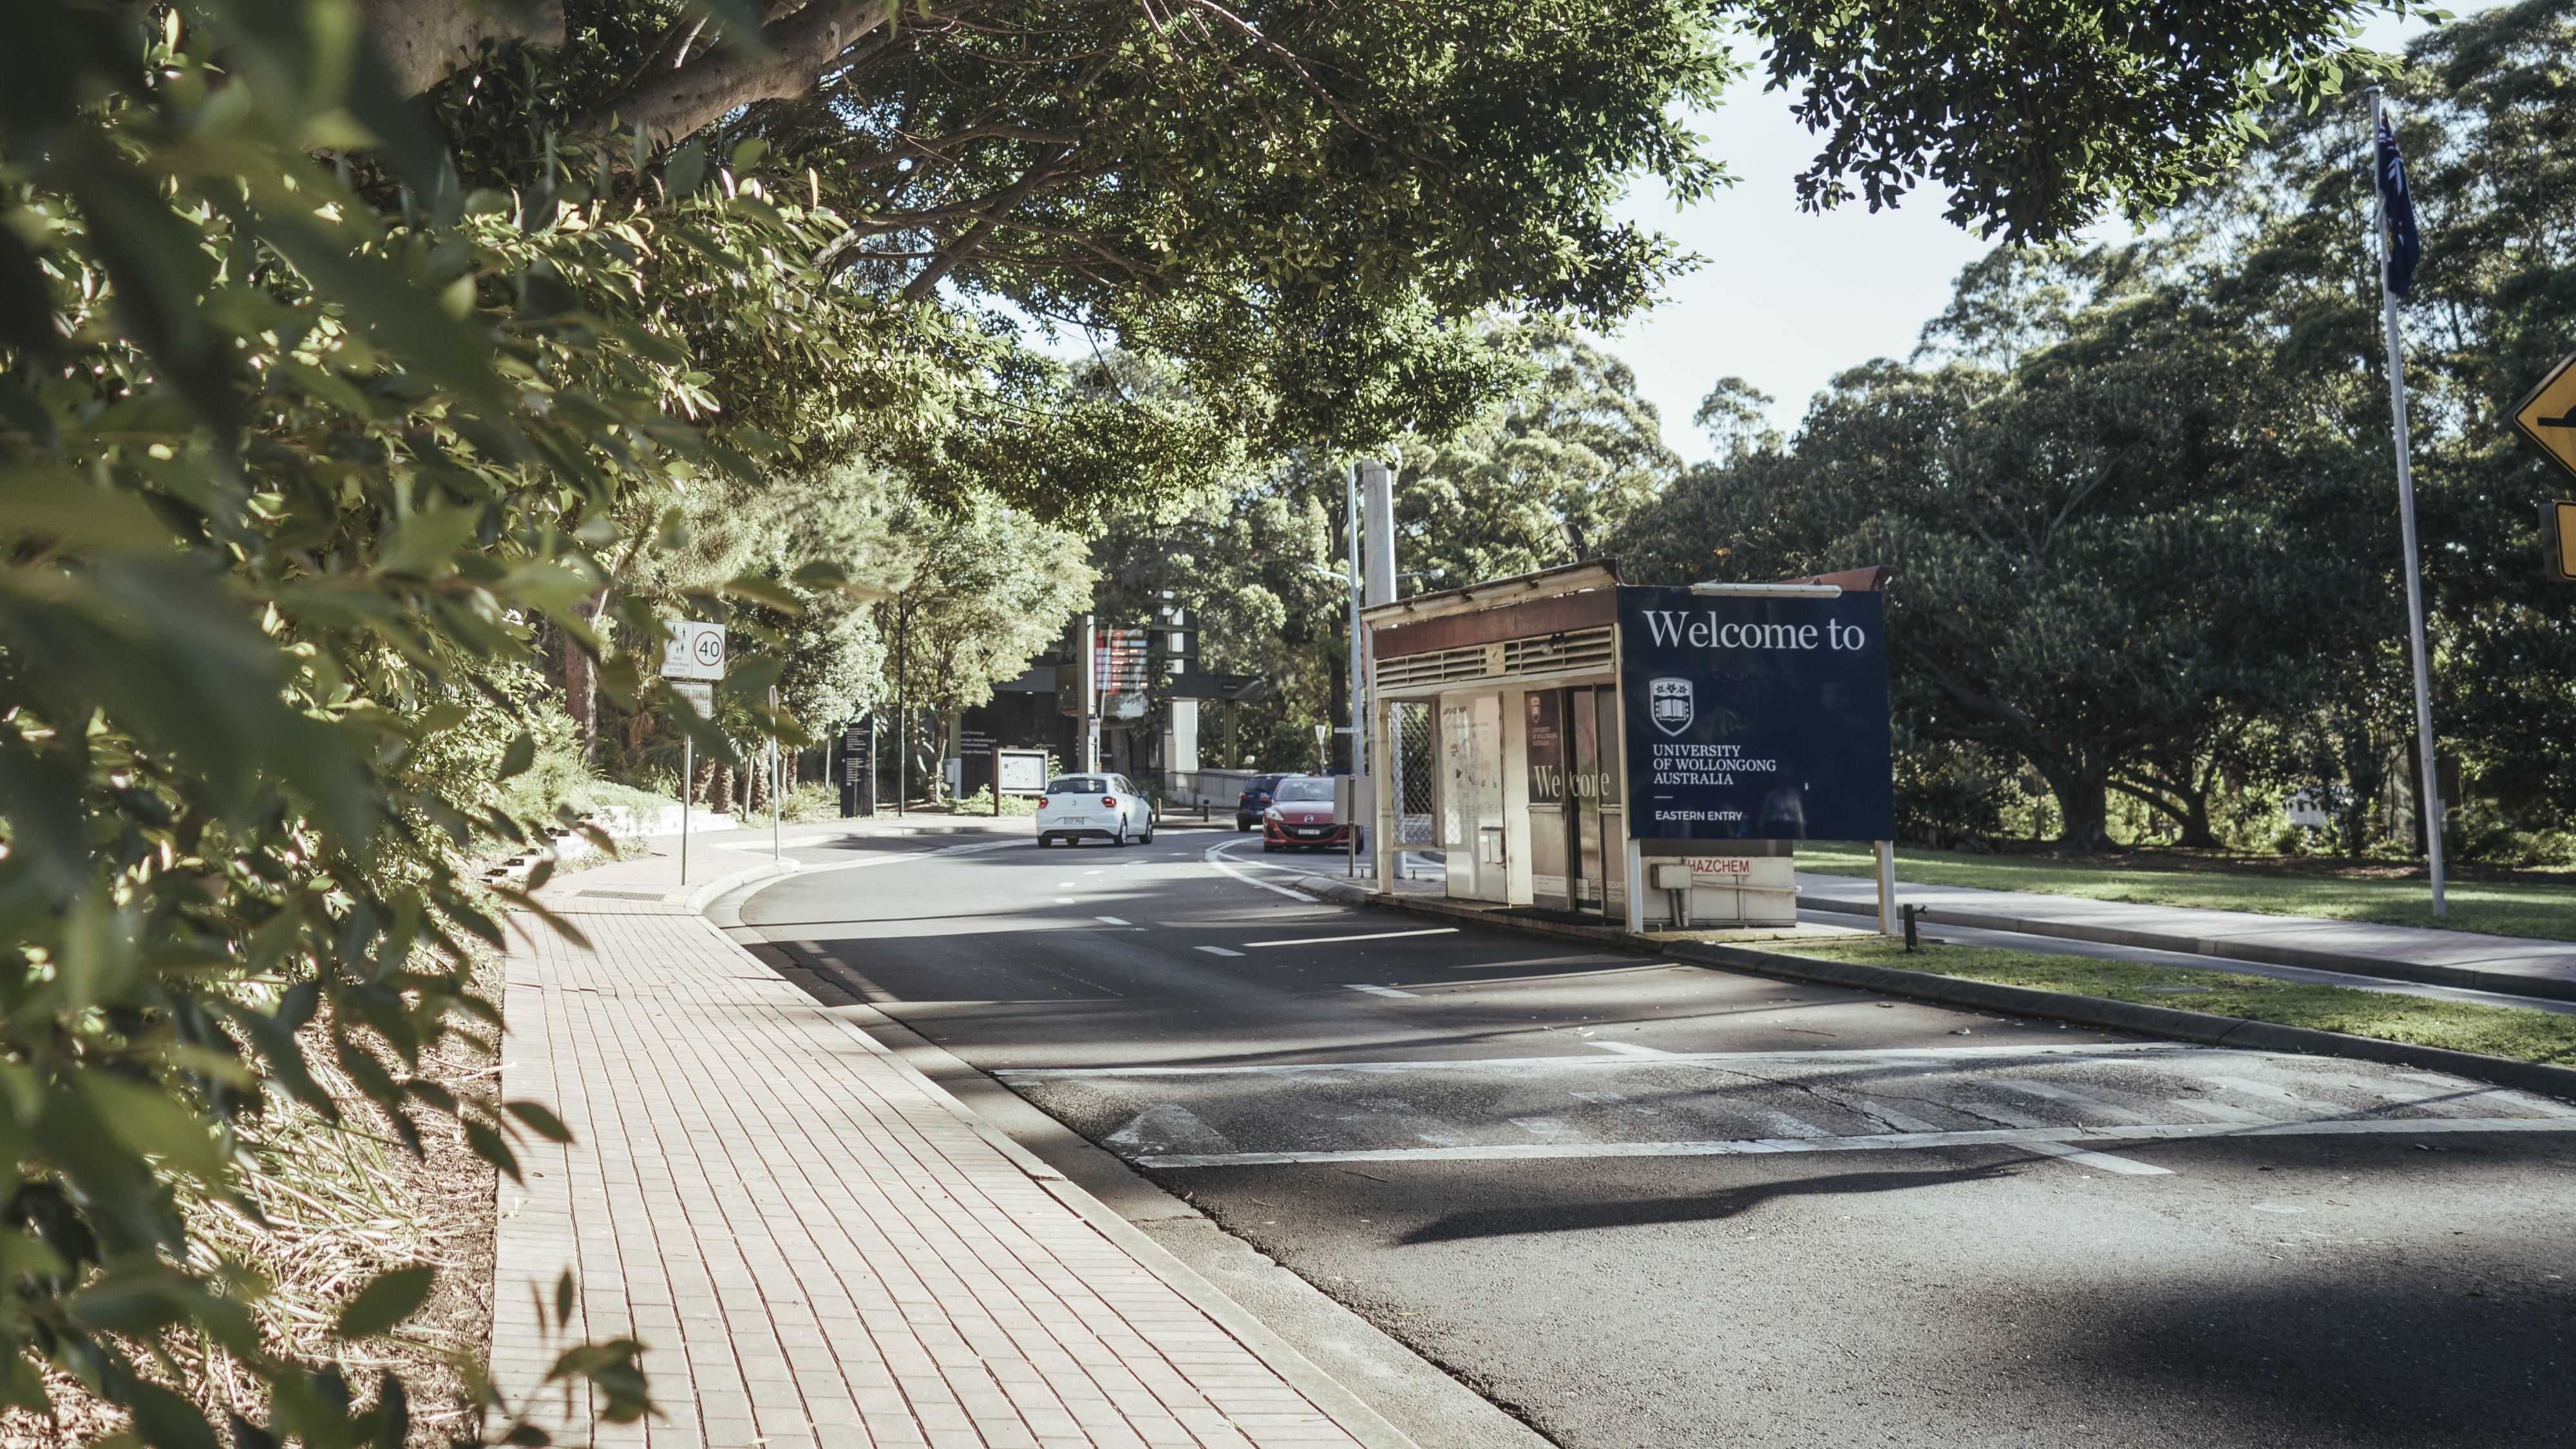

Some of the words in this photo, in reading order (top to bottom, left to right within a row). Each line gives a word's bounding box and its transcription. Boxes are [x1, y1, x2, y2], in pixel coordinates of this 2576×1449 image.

[1642, 610, 1818, 650] Welcome
[1826, 618, 1865, 650] to
[699, 641, 720, 658] 40
[674, 688, 690, 699] EED
[692, 689, 709, 700] ZONES
[1653, 744, 1741, 757] UNIVERSITY
[1653, 759, 1673, 771] OF
[1676, 759, 1777, 772] WOLLONGONG
[1533, 765, 1610, 799] Wecoe
[1653, 772, 1734, 785] AUSTRALIA
[1655, 810, 1705, 821] EASTERN
[1707, 811, 1743, 821] ENTRY
[1687, 859, 1750, 873] HAZCHEM
